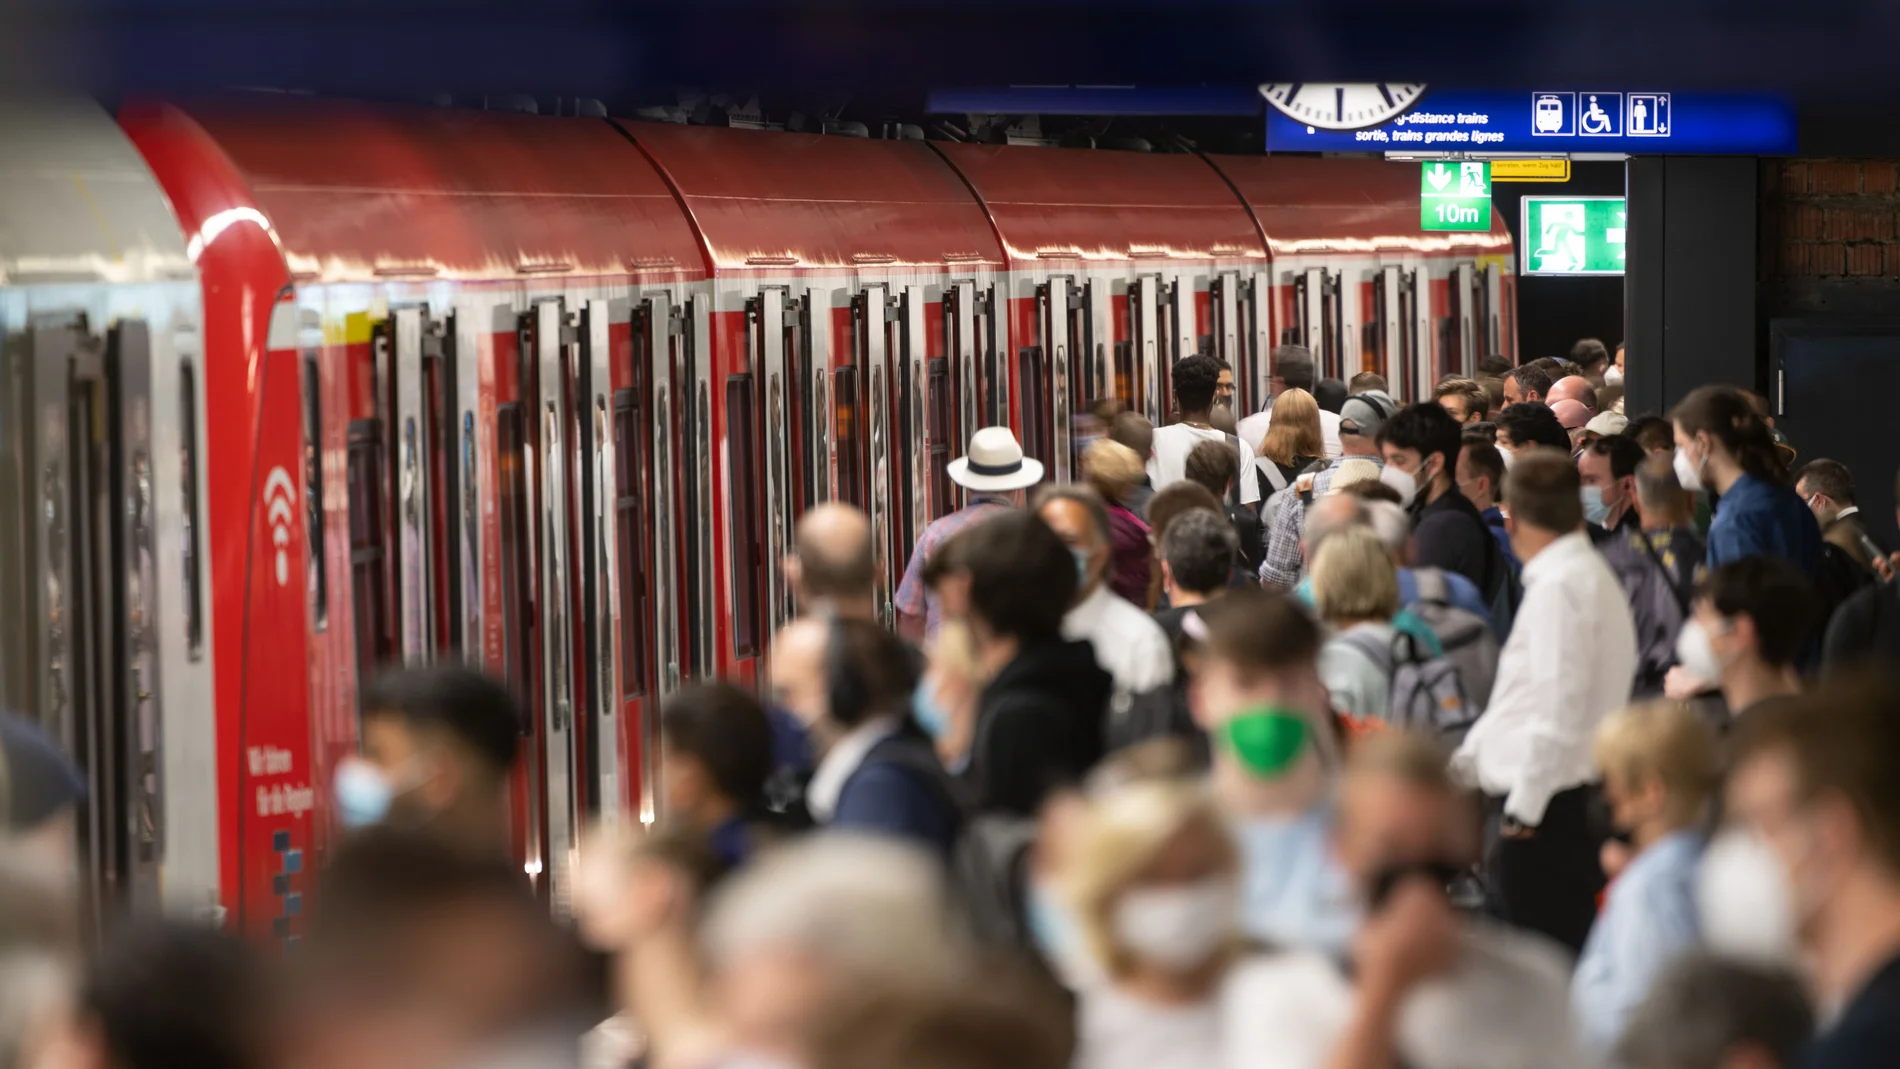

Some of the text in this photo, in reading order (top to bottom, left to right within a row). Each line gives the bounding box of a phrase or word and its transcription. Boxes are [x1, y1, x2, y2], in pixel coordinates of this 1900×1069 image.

[1394, 112, 1488, 126] g-distance trains
[1355, 129, 1504, 144] sortie, trains grandes lignes
[1435, 203, 1479, 223] 10m
